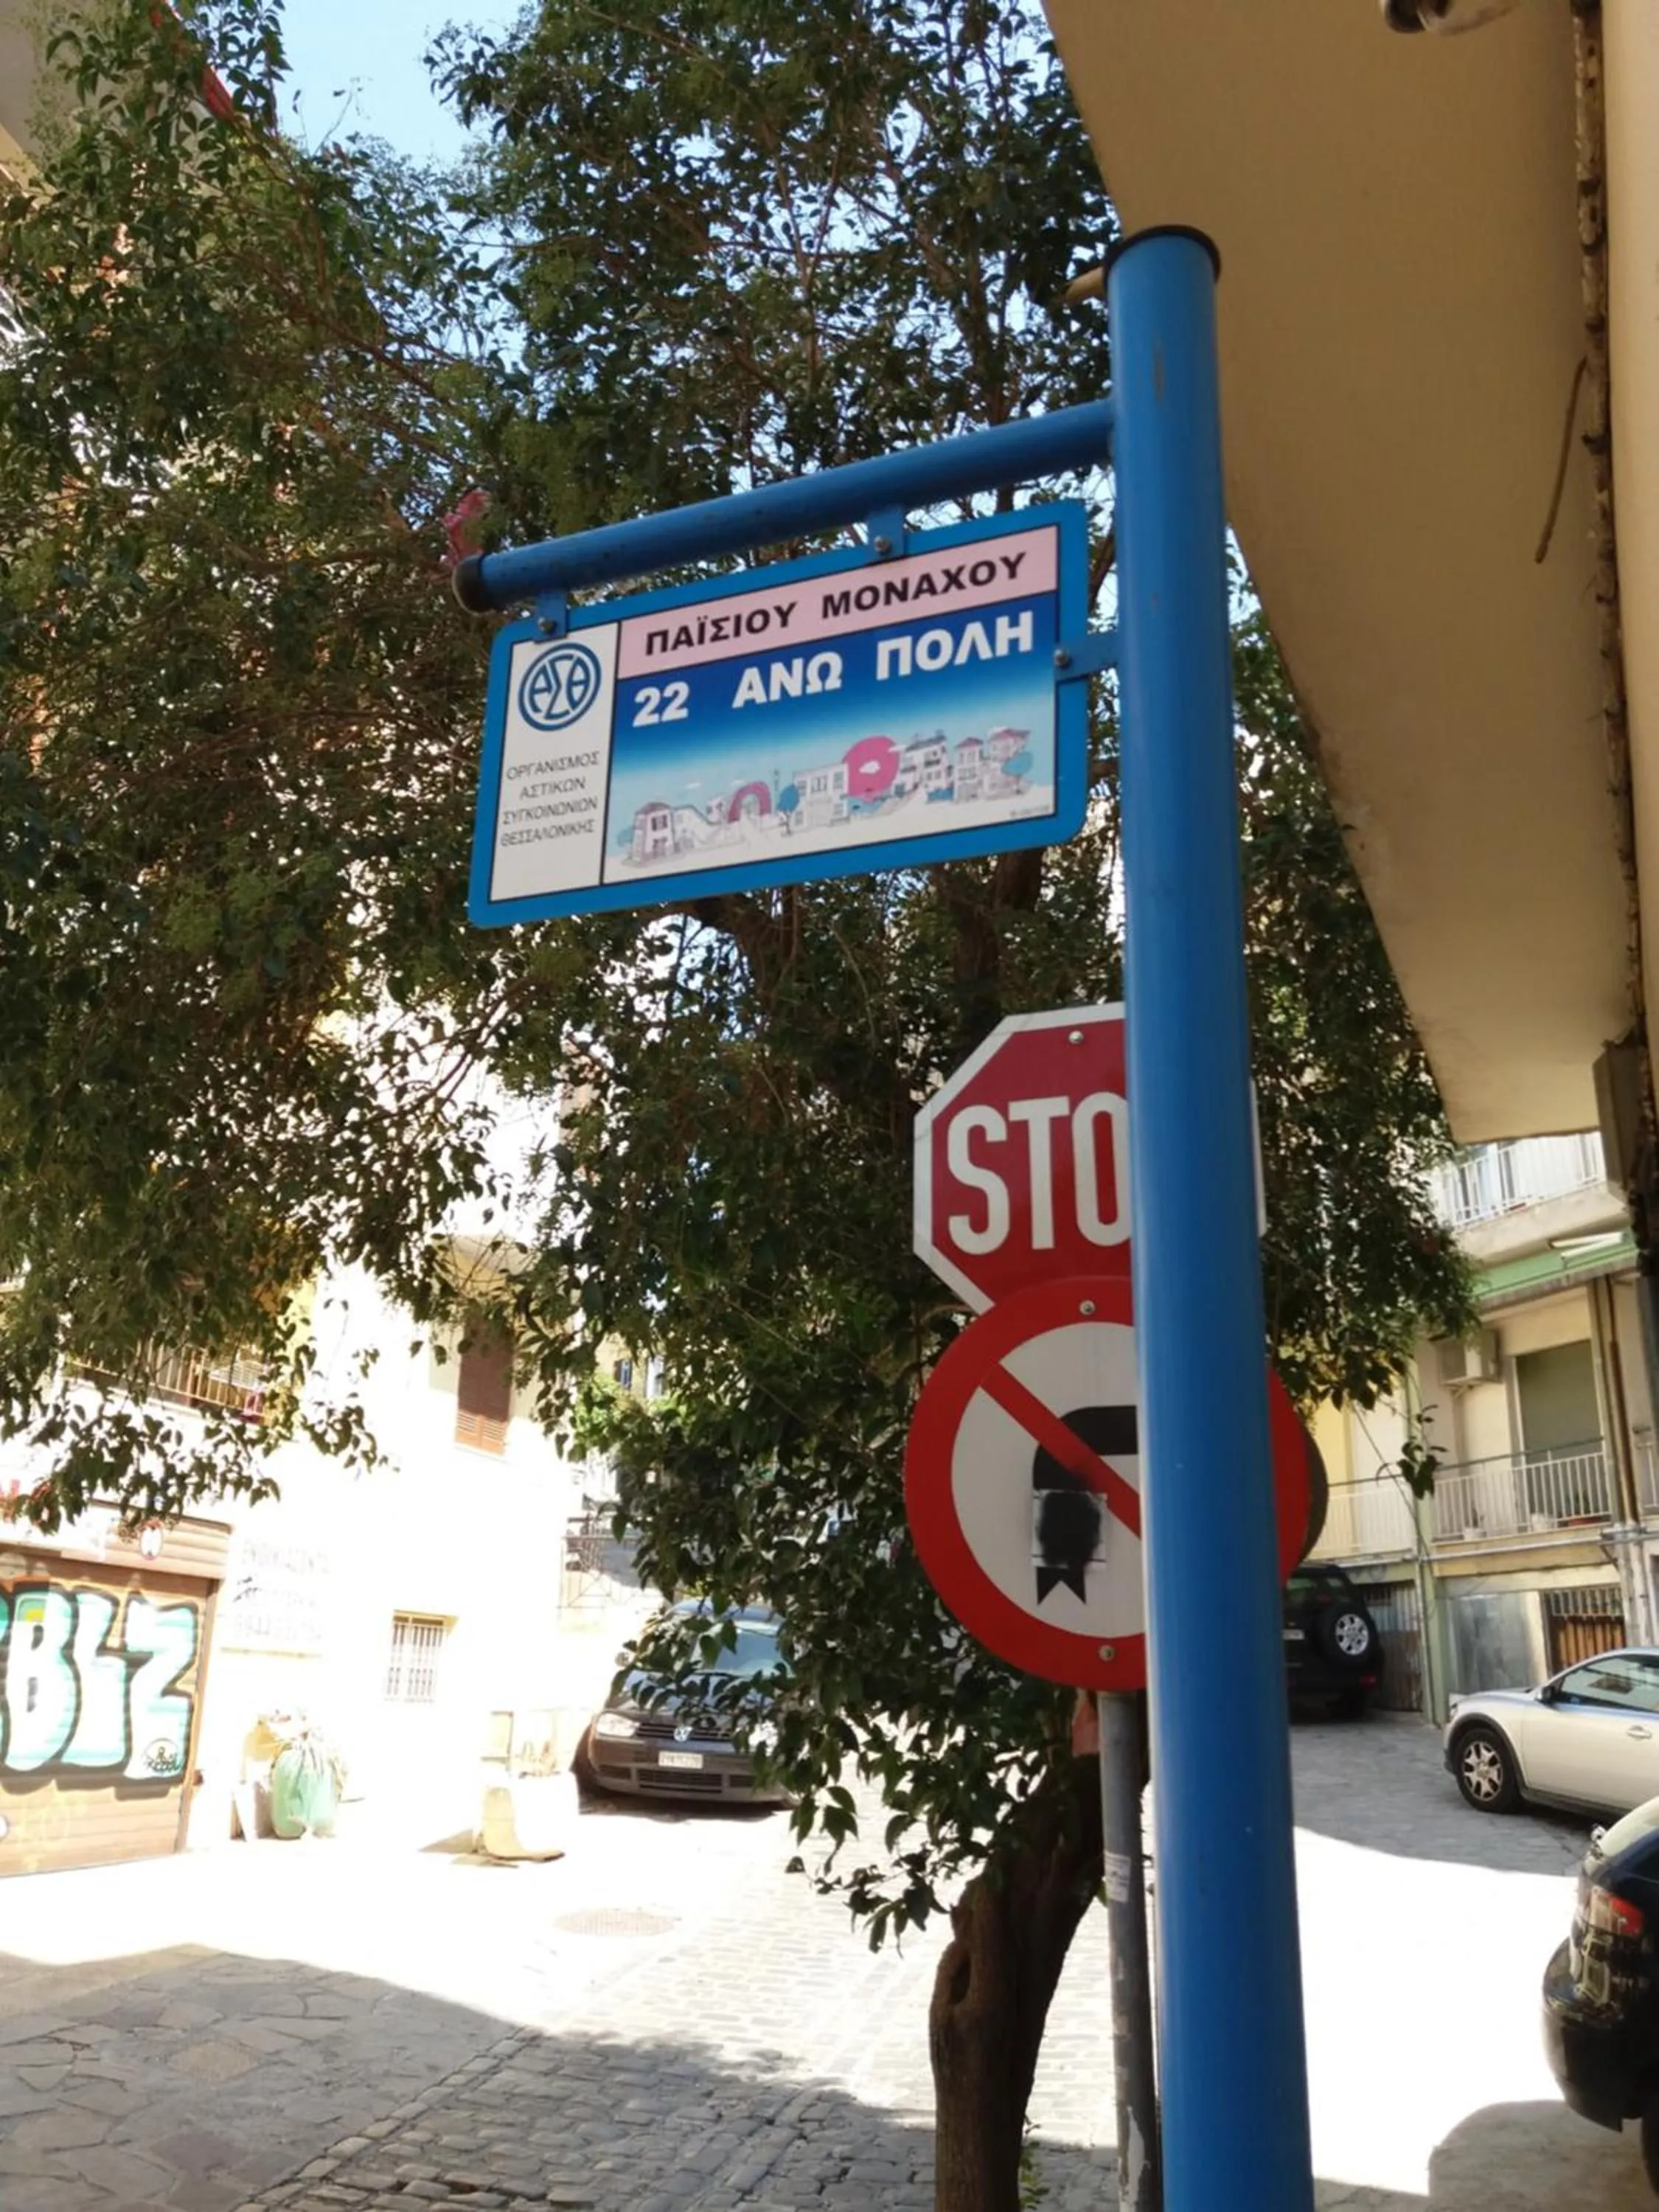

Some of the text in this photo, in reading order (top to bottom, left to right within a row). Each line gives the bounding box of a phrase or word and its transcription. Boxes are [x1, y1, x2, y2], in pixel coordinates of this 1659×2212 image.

[645, 552, 1026, 656] ΠΑΪΣΙΟΥ ΜΟΝΑΧΟΥ
[632, 611, 1034, 728] 22 ΑΝΩ ΠΟΛΗ
[506, 750, 601, 781] ΟΡΓΑΝΙΣΜΟΣ
[519, 776, 587, 801] ΑΣΤΙΚΩΝ
[947, 1091, 1132, 1256] STO
